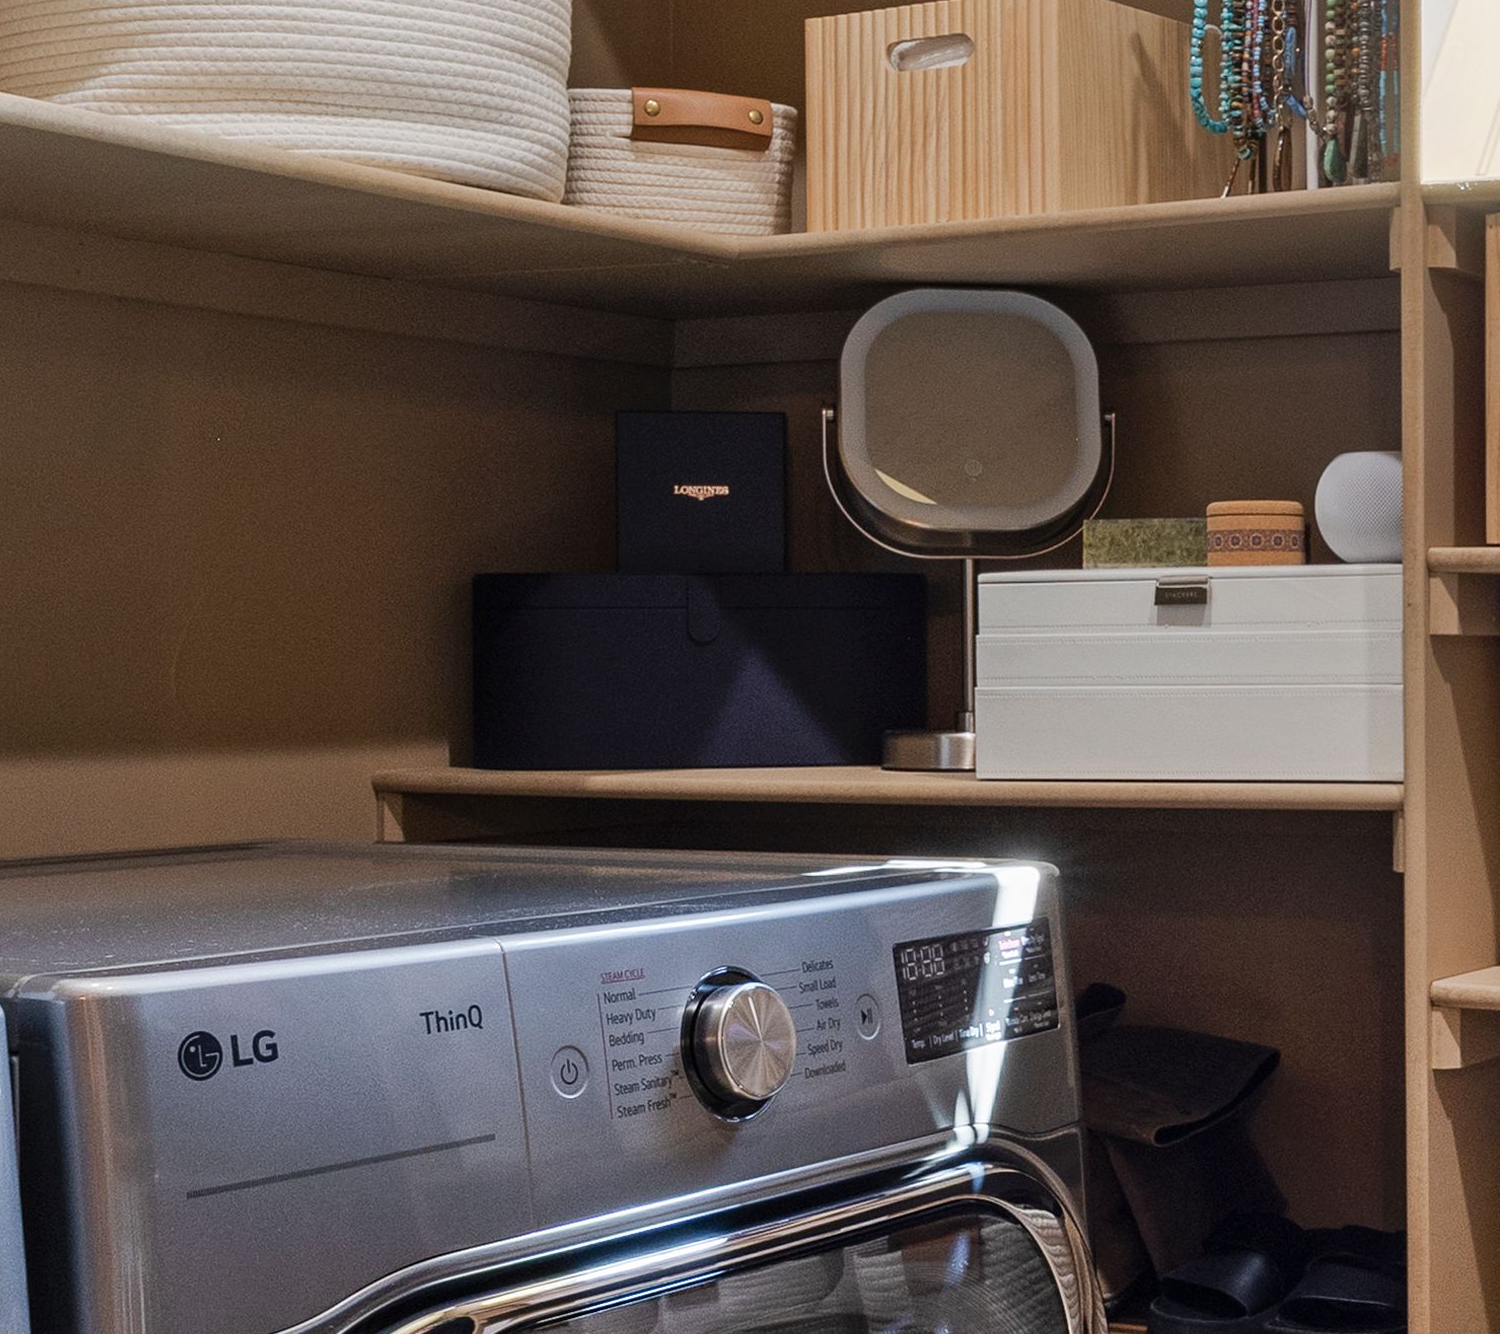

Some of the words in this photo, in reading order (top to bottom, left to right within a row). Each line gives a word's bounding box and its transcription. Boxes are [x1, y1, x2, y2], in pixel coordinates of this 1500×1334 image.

[674, 485, 730, 496] LONGINES
[601, 970, 623, 983] STEAM
[624, 968, 644, 979] CYCLE
[799, 980, 818, 994] Small
[820, 977, 836, 989] Load
[604, 988, 636, 1005] Normal
[420, 1005, 484, 1034] ThinQ
[606, 1012, 633, 1025] Heavy
[636, 1007, 656, 1021] Duty
[609, 1031, 644, 1047] Bedding
[230, 1030, 279, 1067] LG
[808, 1042, 829, 1058] Speed
[830, 1039, 843, 1053] Dry
[612, 1057, 637, 1072] Perm.
[639, 1053, 662, 1067] Press
[614, 1081, 640, 1096] Steam
[618, 1103, 646, 1119] Steam
